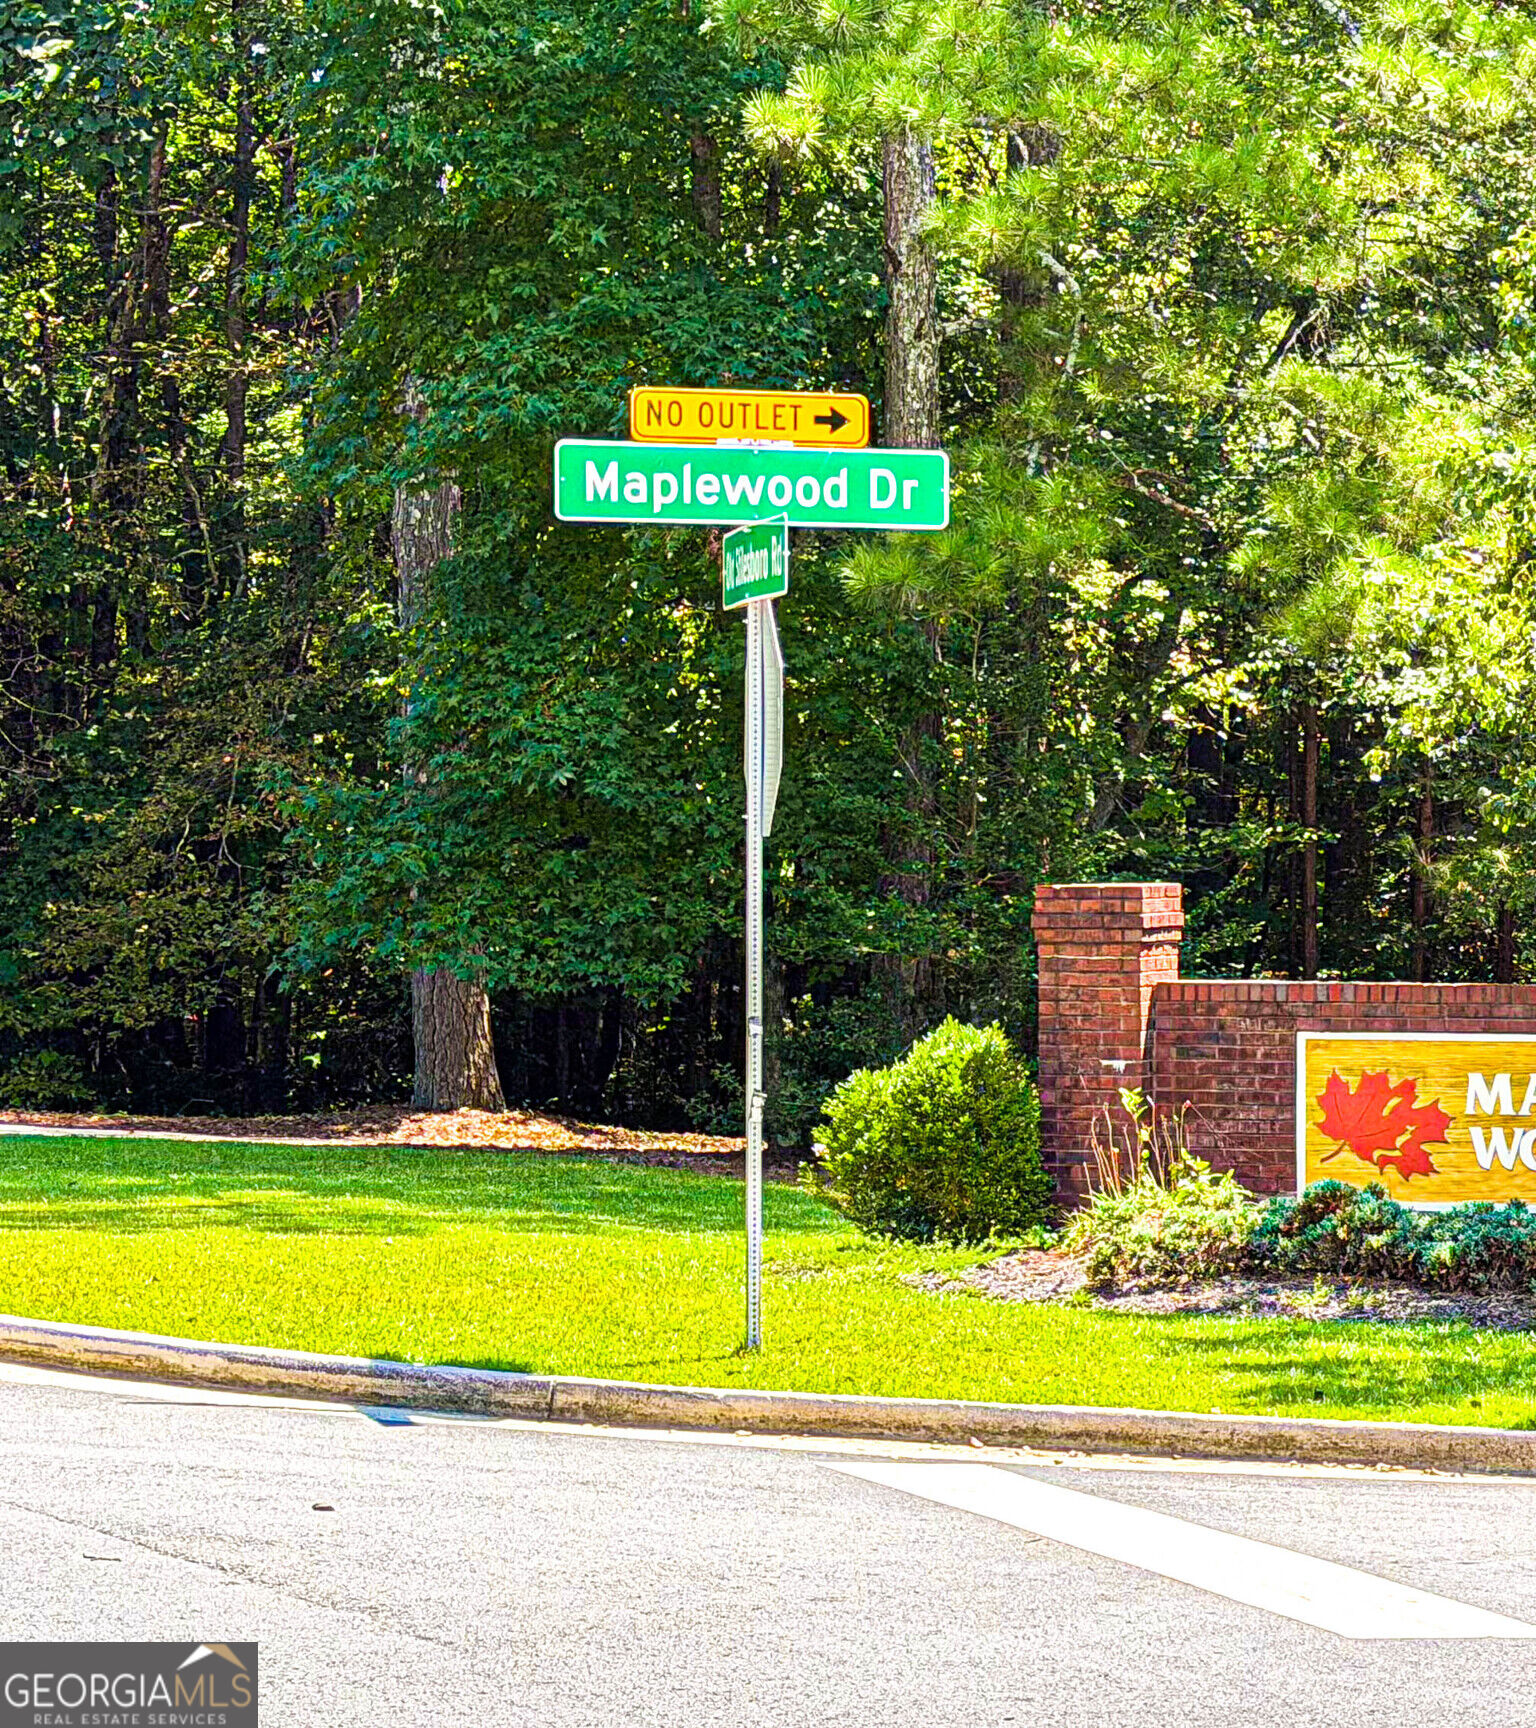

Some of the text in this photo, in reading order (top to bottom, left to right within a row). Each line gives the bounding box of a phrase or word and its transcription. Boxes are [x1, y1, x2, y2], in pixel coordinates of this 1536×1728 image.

[646, 399, 802, 431] NO OUTLET
[585, 460, 919, 513] Maplewood Dr
[771, 533, 783, 577] Rd
